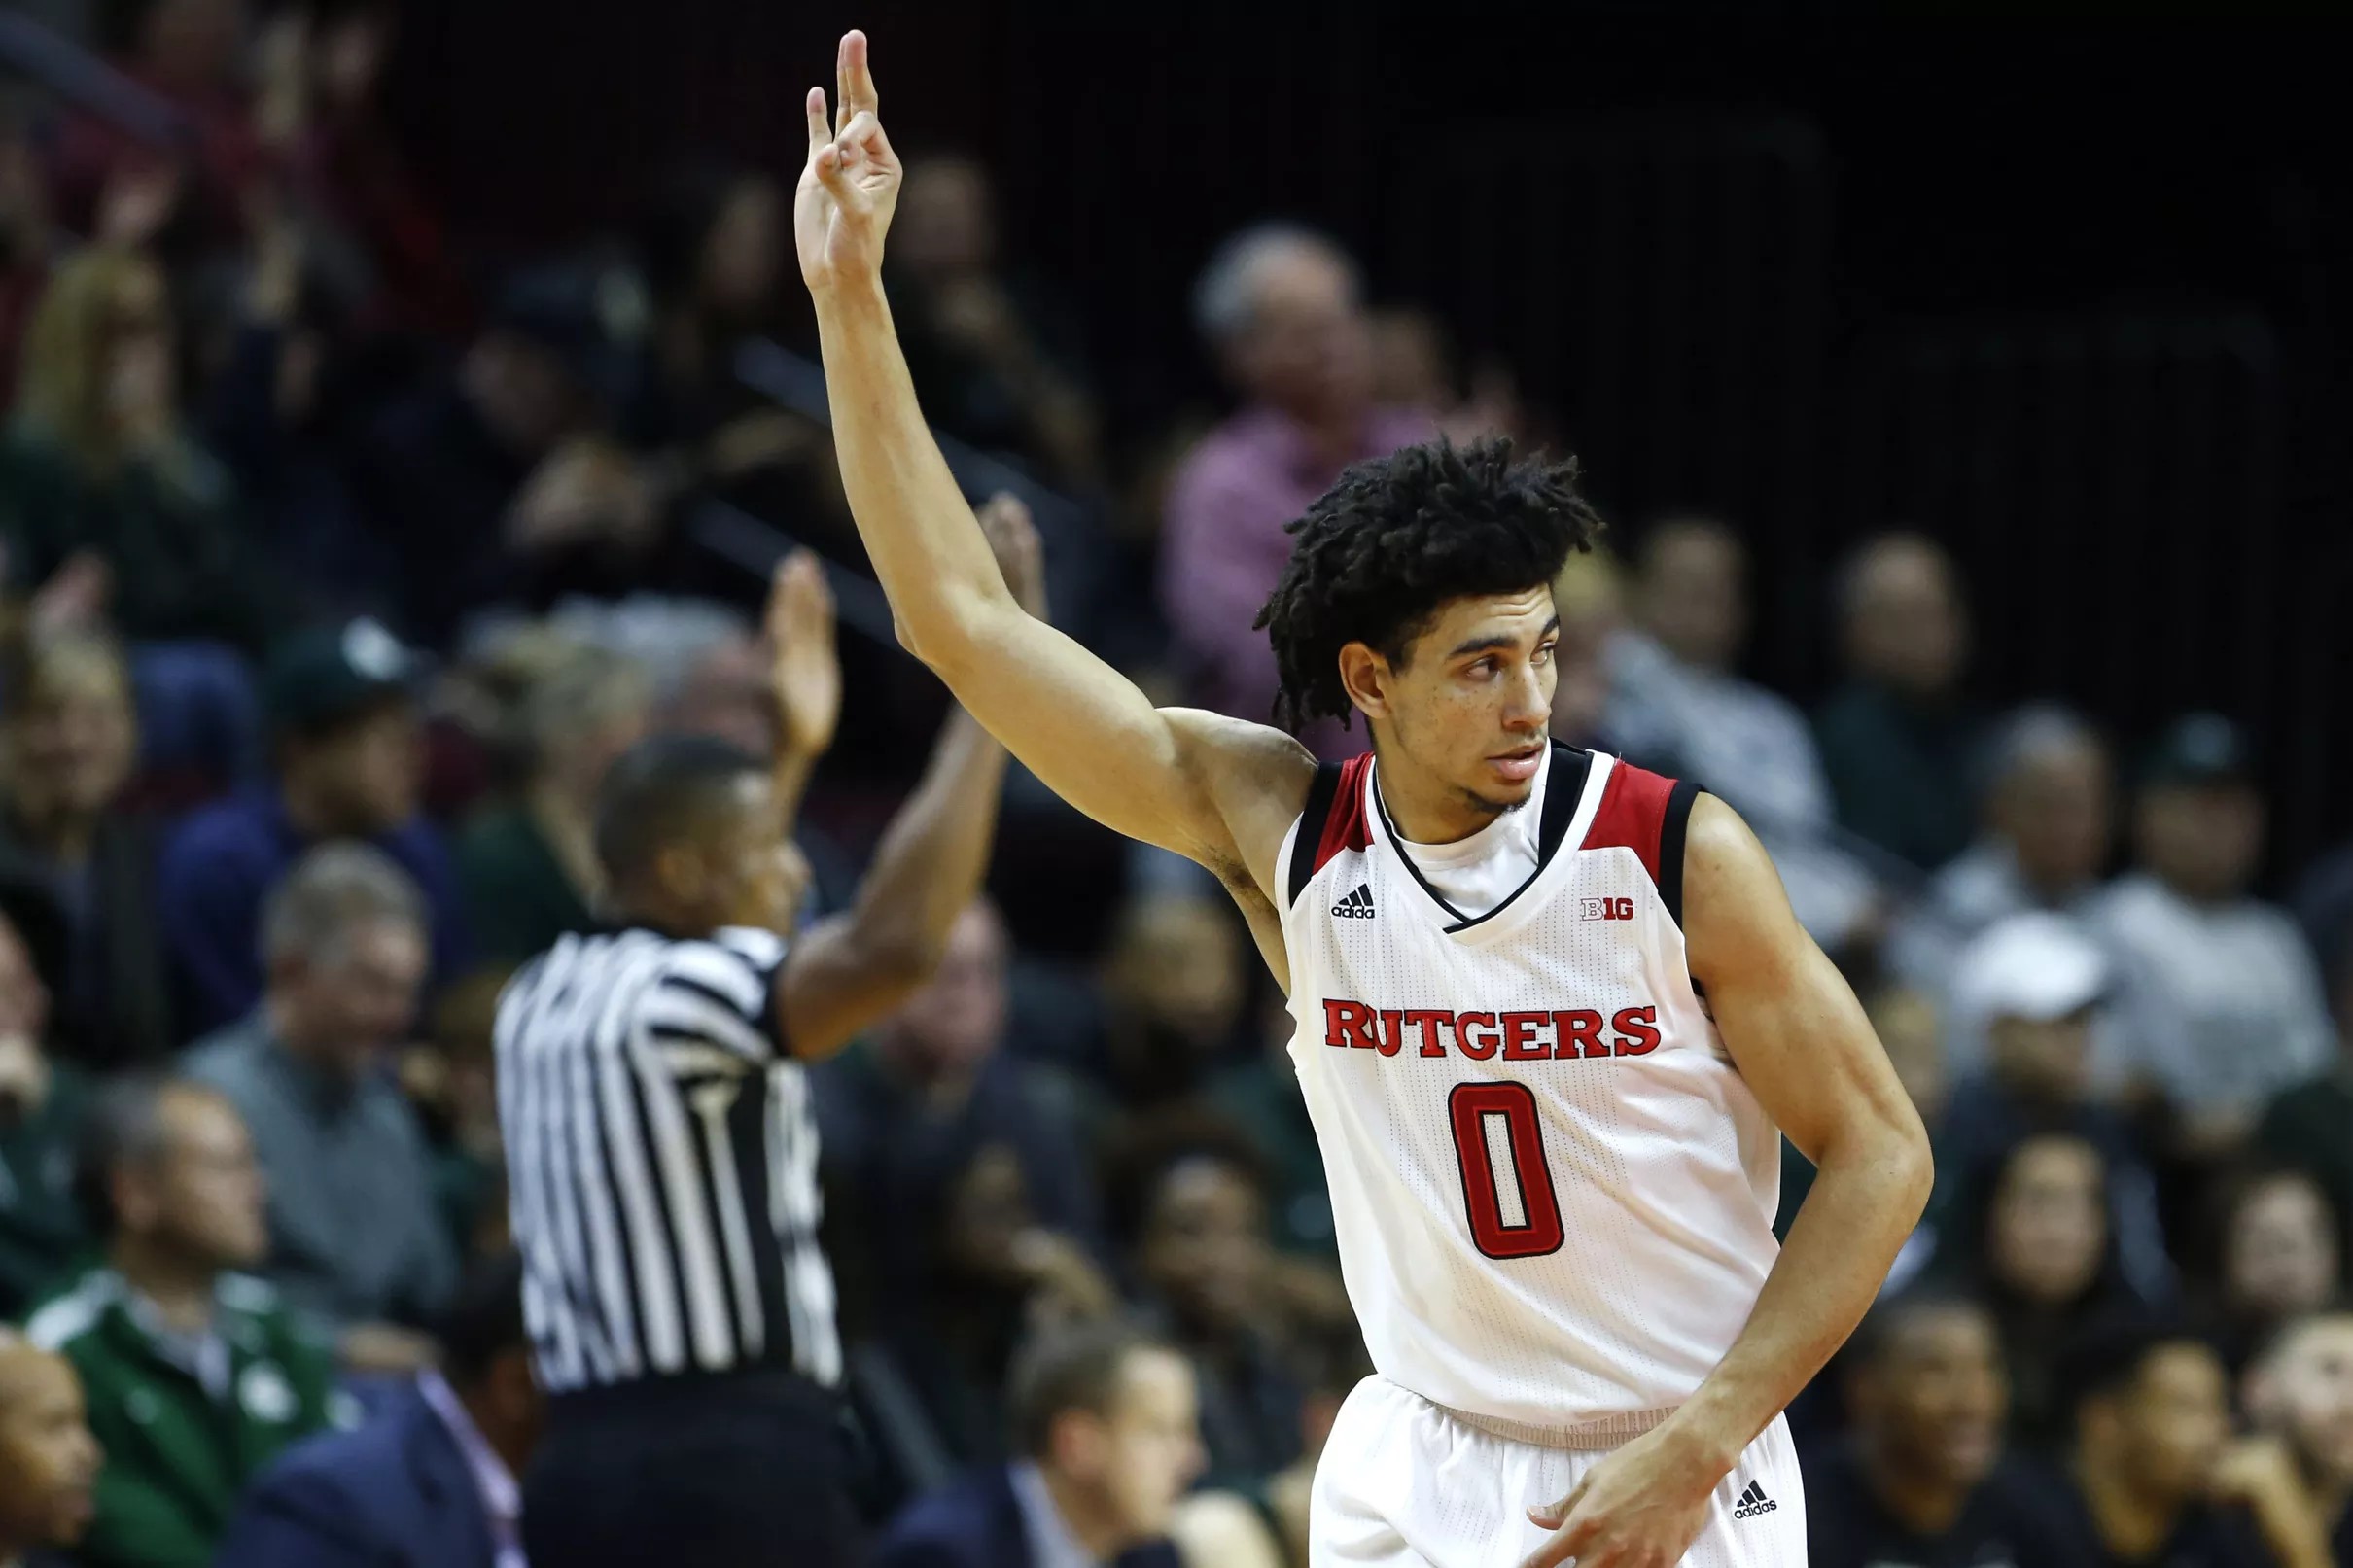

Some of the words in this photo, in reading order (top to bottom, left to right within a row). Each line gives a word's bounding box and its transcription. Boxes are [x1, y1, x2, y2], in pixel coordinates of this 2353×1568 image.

[1331, 905, 1376, 920] adida
[1323, 999, 1661, 1062] RUTGERS
[1449, 1081, 1565, 1260] 0
[1735, 1500, 1777, 1519] adidas
